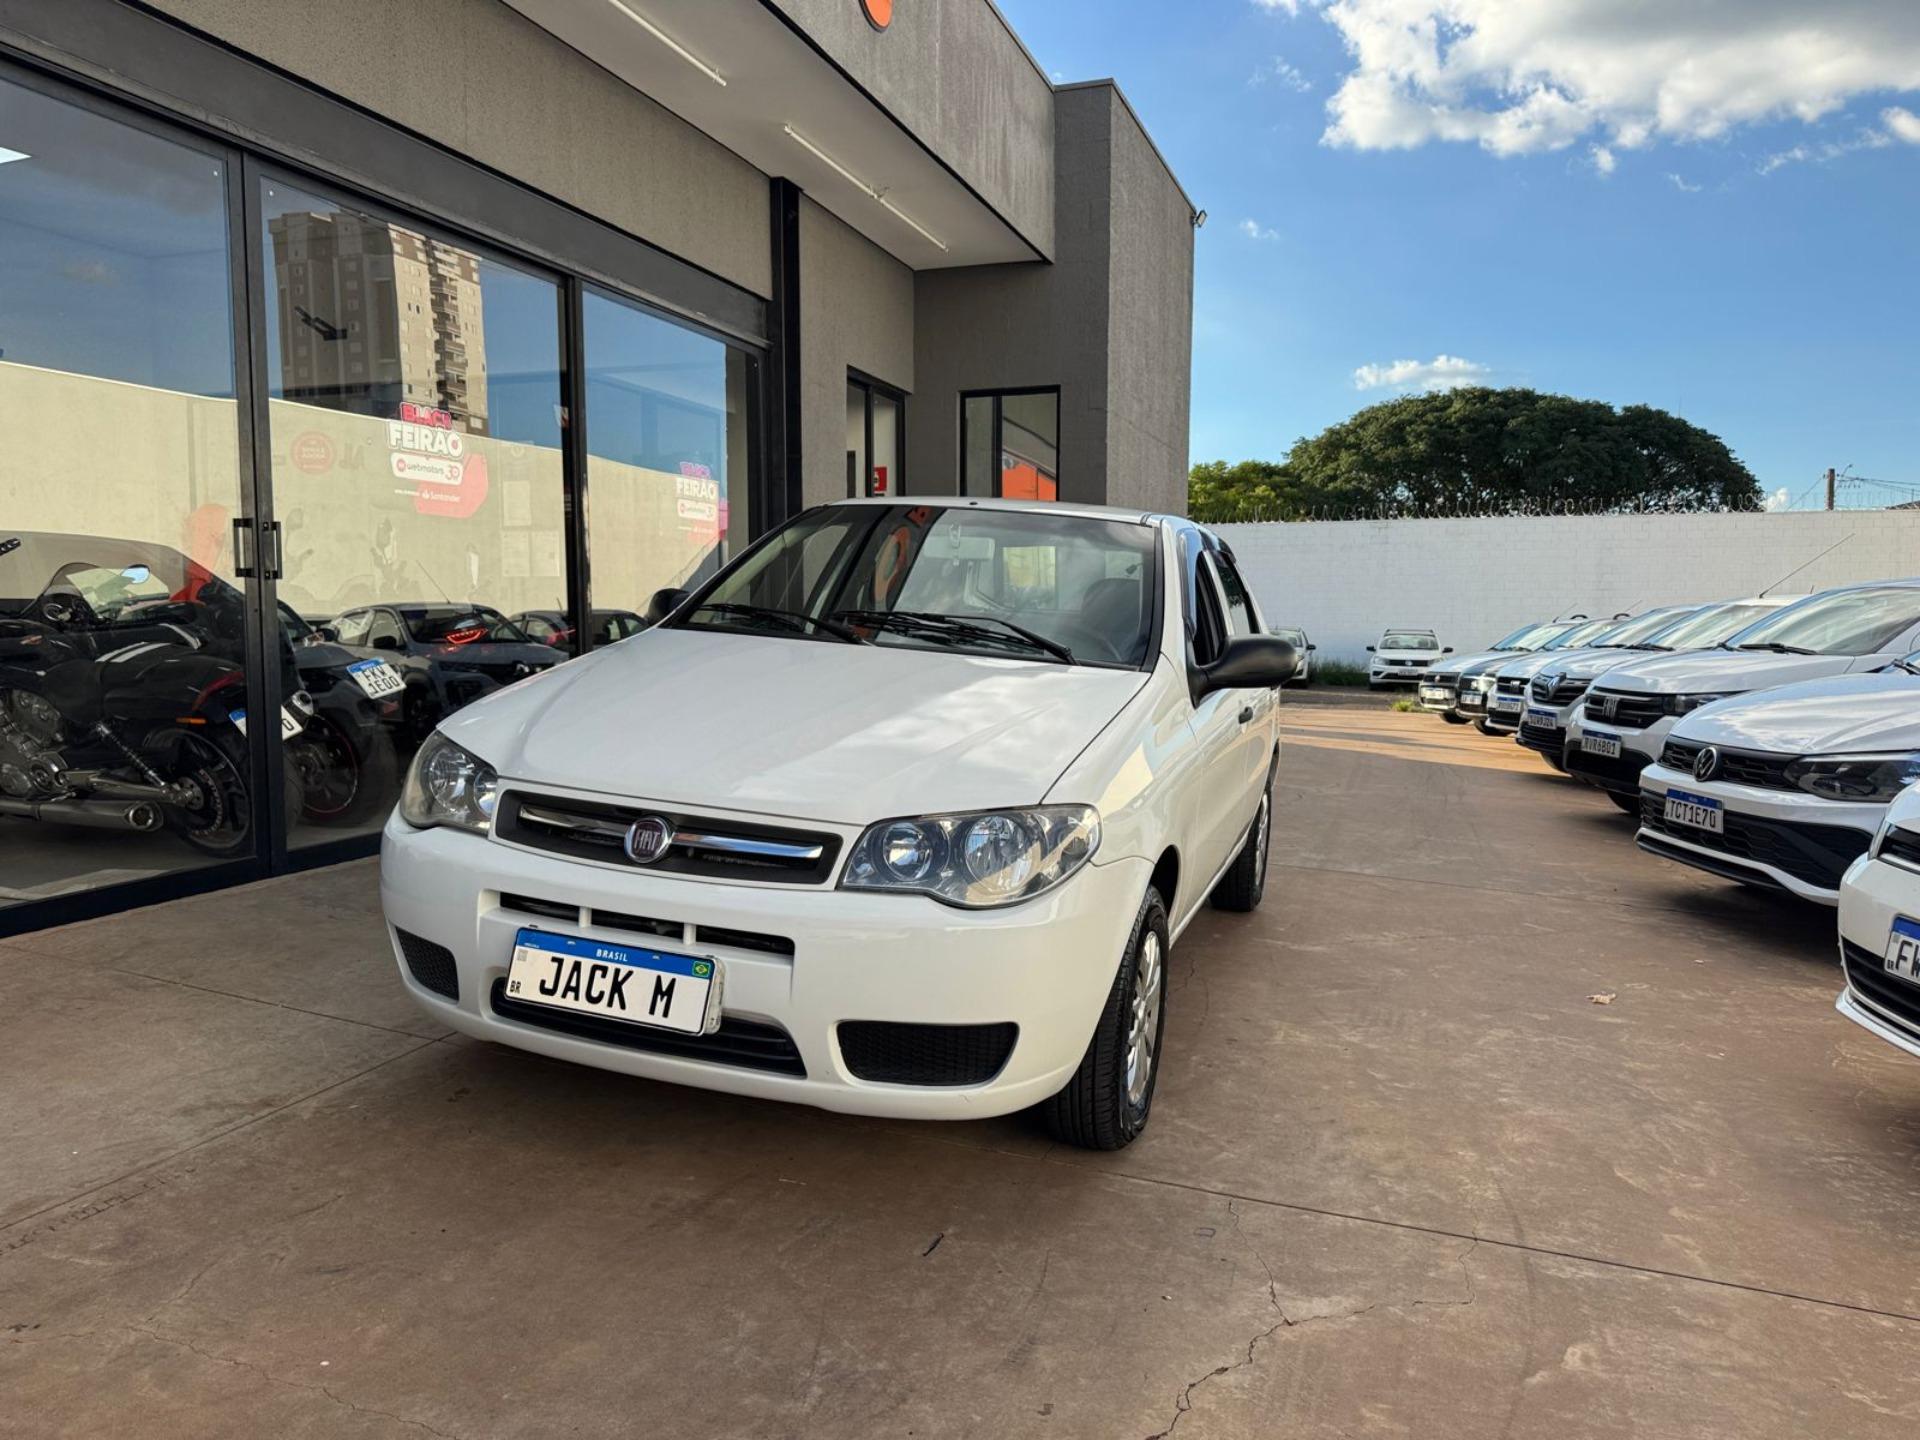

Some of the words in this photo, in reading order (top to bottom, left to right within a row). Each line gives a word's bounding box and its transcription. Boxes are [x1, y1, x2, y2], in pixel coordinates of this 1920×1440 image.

[1669, 800, 1716, 828] TCT1E70
[633, 829, 661, 851] FIAT
[596, 948, 628, 962] BRASIL
[509, 980, 521, 993] BR
[539, 957, 634, 1011] JACK
[649, 974, 676, 1019] M
